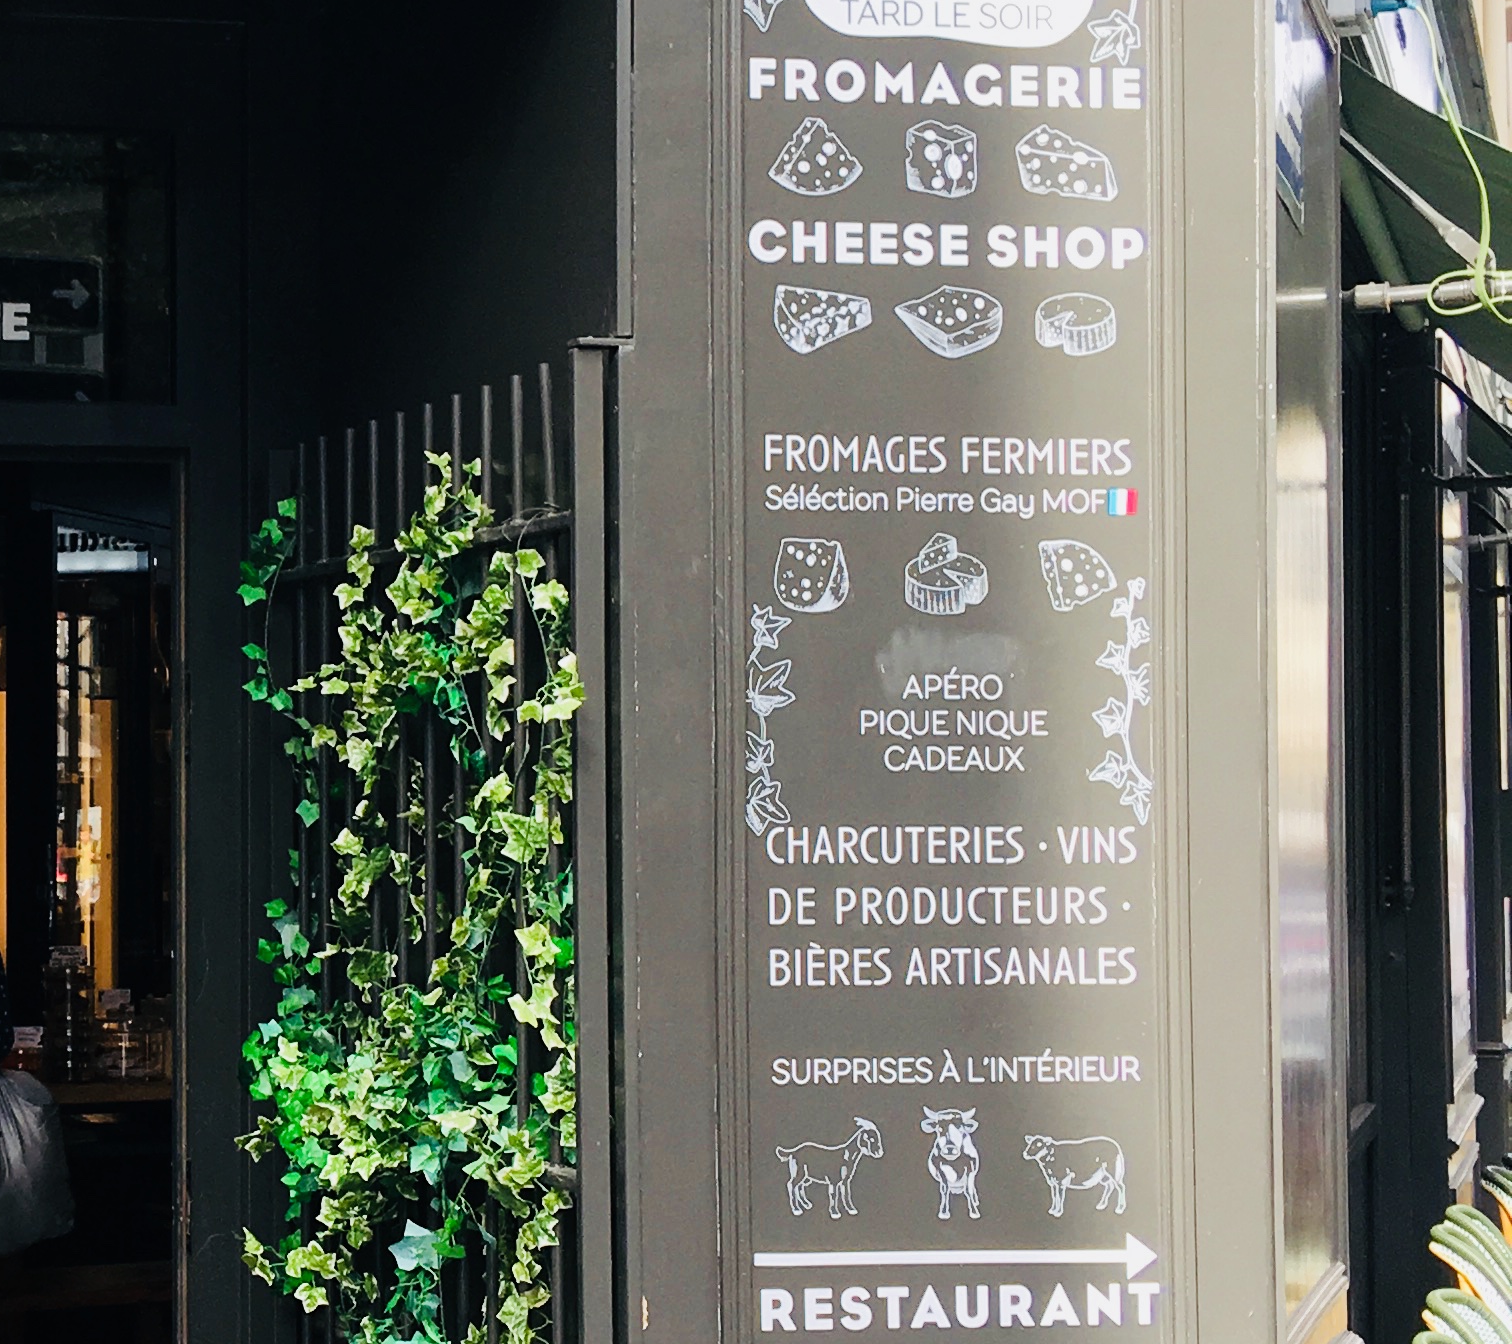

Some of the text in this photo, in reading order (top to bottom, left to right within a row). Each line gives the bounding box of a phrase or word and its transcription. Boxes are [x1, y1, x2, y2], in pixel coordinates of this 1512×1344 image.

[935, 1, 970, 28] LE
[980, 3, 1053, 29] SOIR
[749, 58, 1141, 108] FROMAGERIE
[748, 219, 1144, 269] CHEESE SHOP
[764, 434, 1132, 476] FROMAGES FERMIERS
[764, 484, 1106, 519] Séléction Pierre Gay MOF
[902, 667, 1003, 700] APÉRO
[860, 709, 1048, 741] PIQUE NIQUE
[884, 746, 1025, 772] CADEAUX
[765, 825, 1137, 865] CHARCUTERIES VINS
[769, 886, 1107, 925] DE PRODUCTEURS
[769, 943, 1137, 986] BIÈRES ARTISANALES
[772, 1057, 932, 1084] SURPRISES
[939, 1049, 960, 1083] À
[761, 1283, 1160, 1331] RESTAURANT
